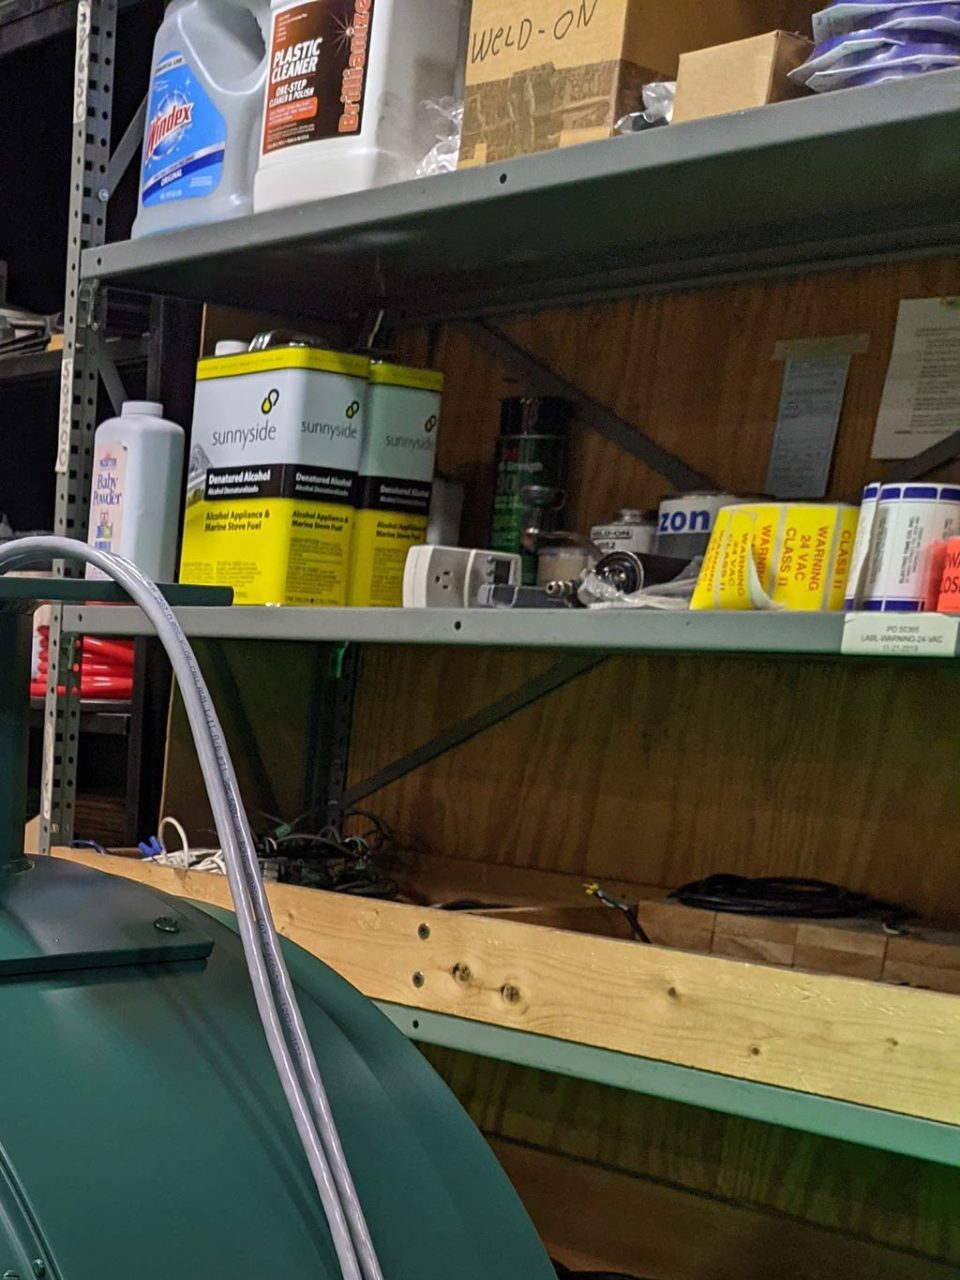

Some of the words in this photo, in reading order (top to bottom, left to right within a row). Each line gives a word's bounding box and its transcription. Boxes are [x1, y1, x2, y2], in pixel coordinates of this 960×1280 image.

[272, 37, 323, 69] PLASTIC
[271, 57, 319, 84] CLEANER
[276, 79, 308, 97] ONE-STEP
[293, 87, 315, 100] POLISH
[144, 103, 193, 164] Windex
[212, 419, 277, 450] sunnyside
[301, 420, 358, 441] sunnyside
[97, 472, 119, 490] Baby
[208, 471, 244, 485] Denatured
[244, 469, 271, 483] Alcohol
[92, 487, 122, 506] Powder
[204, 522, 226, 532] Marine
[227, 521, 246, 531] Stove
[246, 520, 262, 531] Fuel
[205, 509, 229, 521] Alcohol
[230, 509, 263, 521] Appliance
[660, 509, 711, 532] zon
[779, 527, 797, 573] CLASS
[800, 534, 812, 549] 24
[835, 529, 852, 576] CLASS
[757, 524, 773, 587] WARNIN
[808, 526, 829, 592] WARNING
[794, 553, 809, 582] VAC
